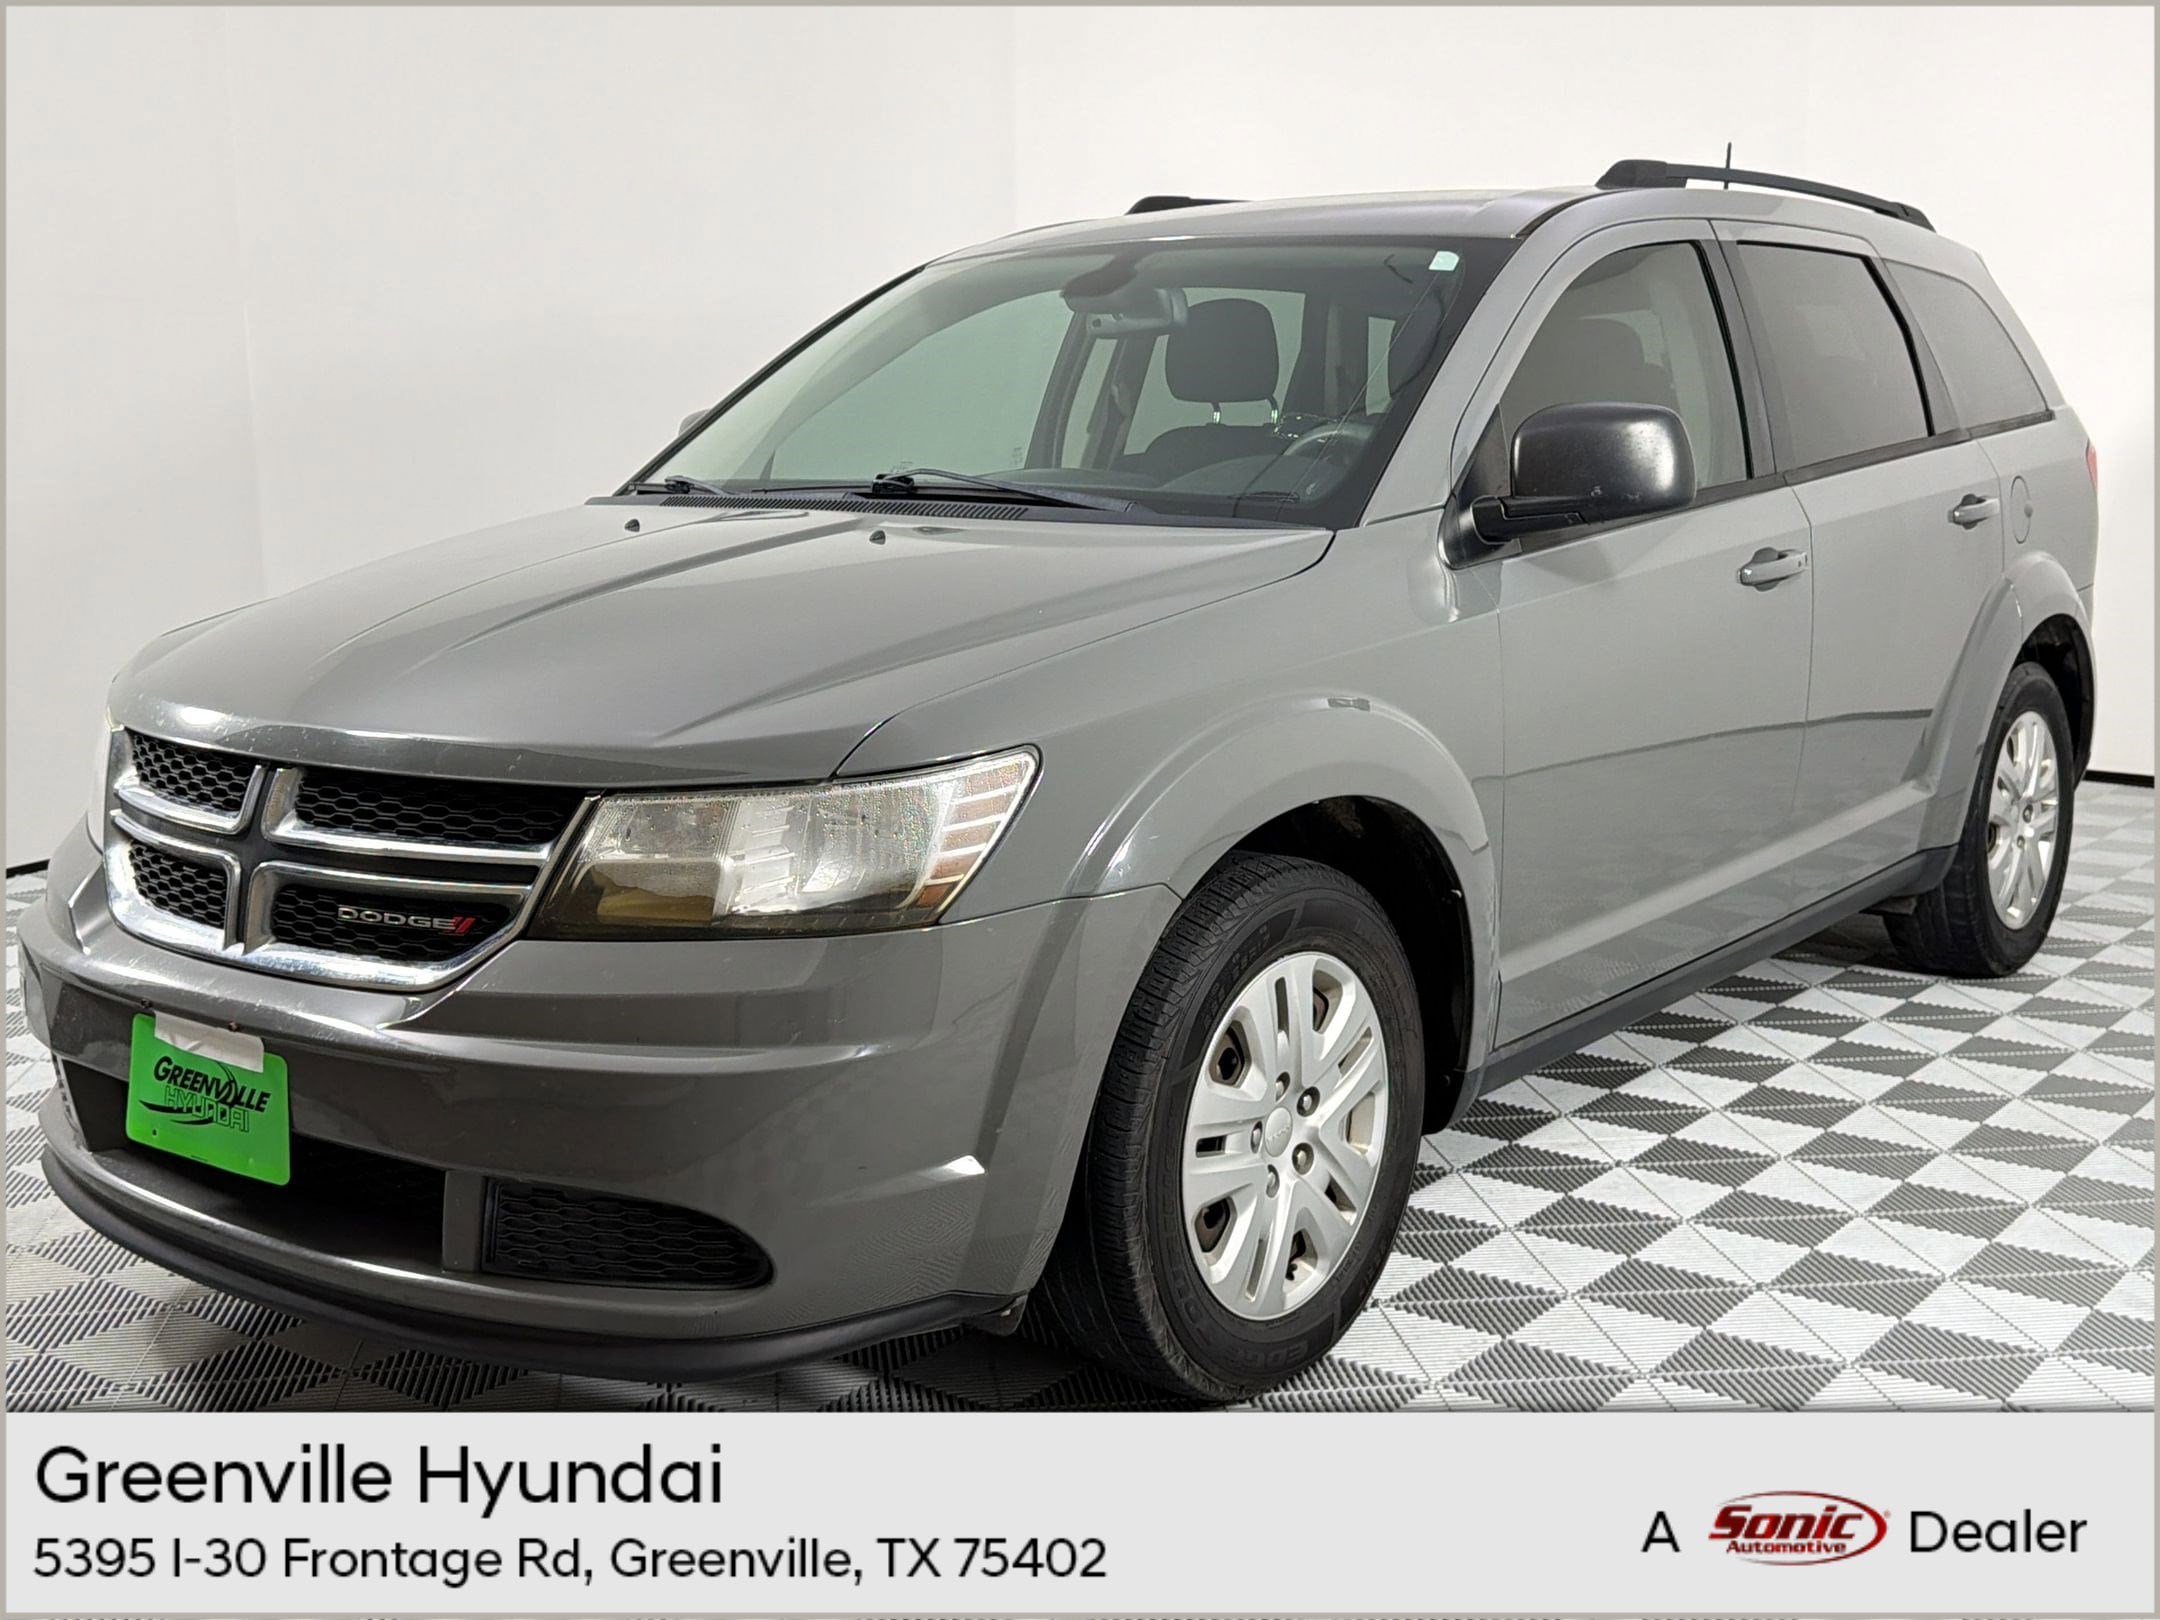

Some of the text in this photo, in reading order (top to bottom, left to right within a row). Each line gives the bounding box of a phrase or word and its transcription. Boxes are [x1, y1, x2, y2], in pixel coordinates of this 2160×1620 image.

[337, 906, 456, 931] DODGE
[153, 1056, 271, 1113] GREENVILLE
[164, 1085, 250, 1133] HYUNDAI
